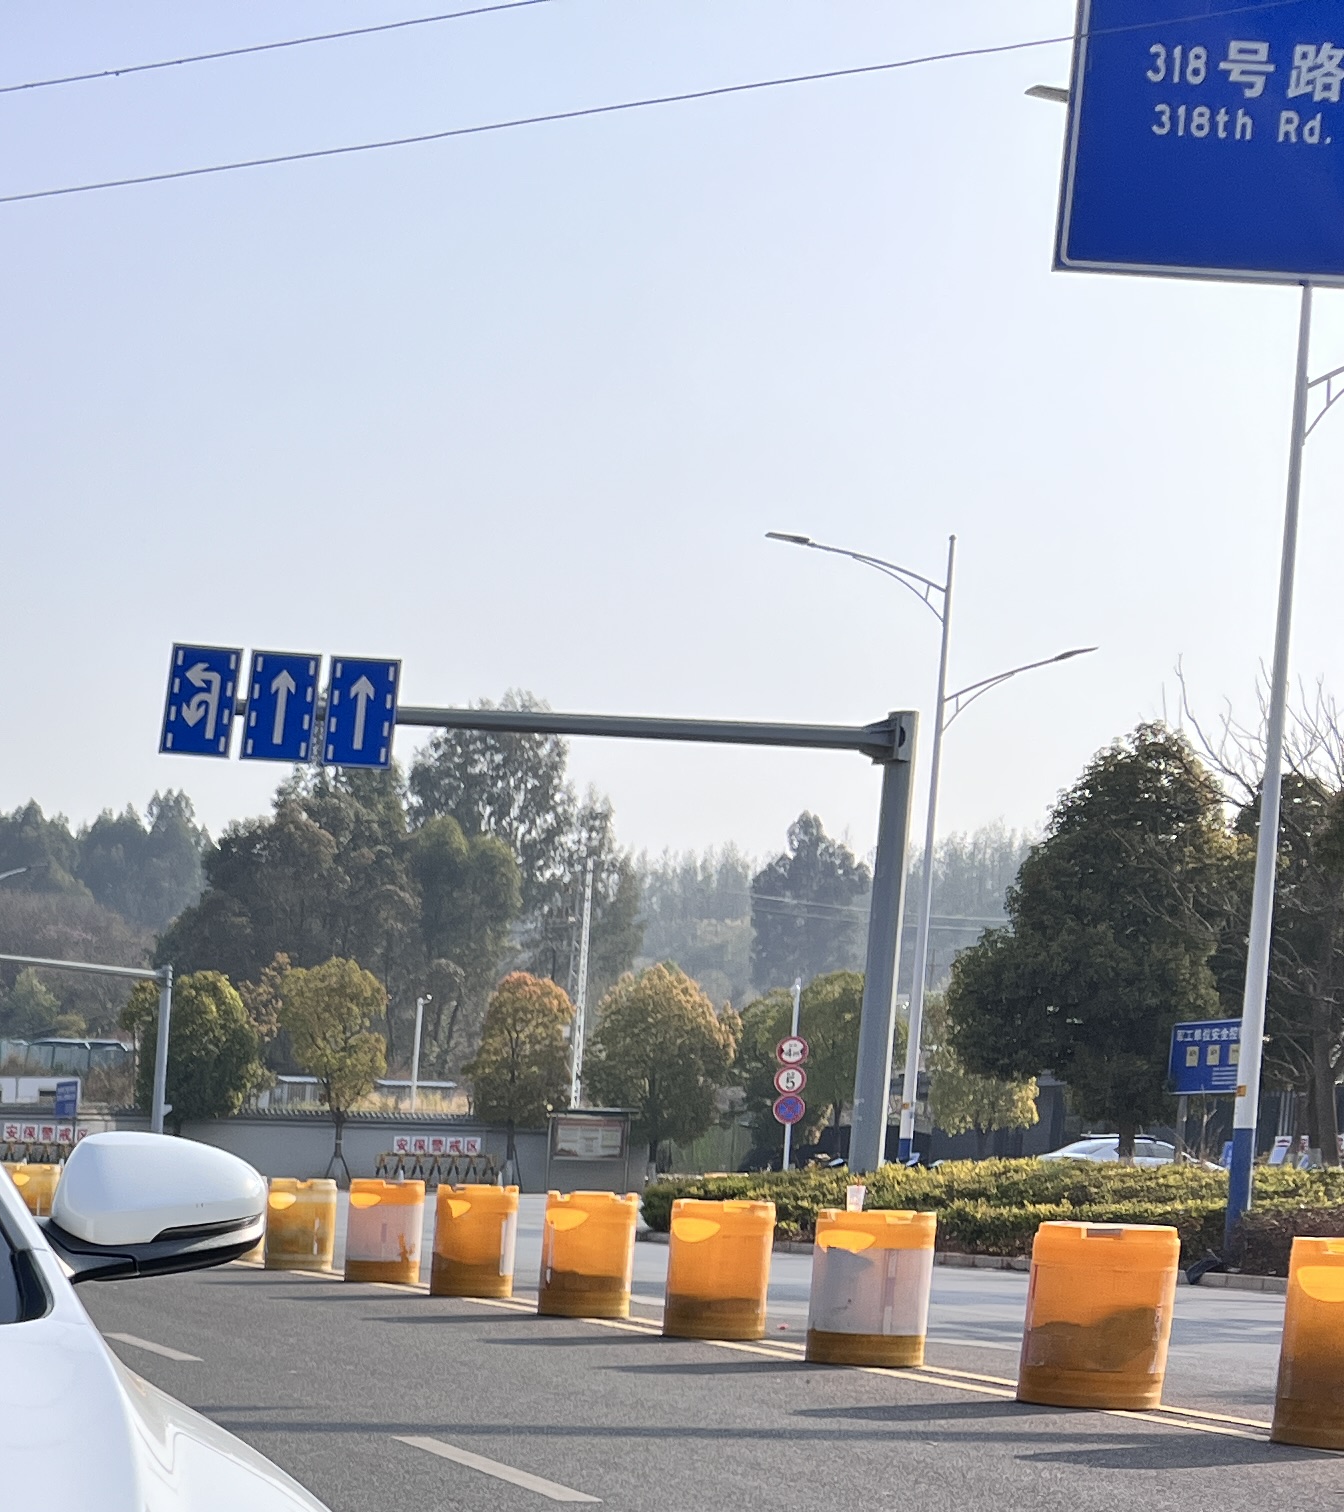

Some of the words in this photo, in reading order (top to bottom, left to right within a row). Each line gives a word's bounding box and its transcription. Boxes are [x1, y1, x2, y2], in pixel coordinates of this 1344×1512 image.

[1151, 104, 1253, 140] 318th
[1278, 110, 1333, 145] Rd.
[396, 1138, 477, 1153] 安保警戒区
